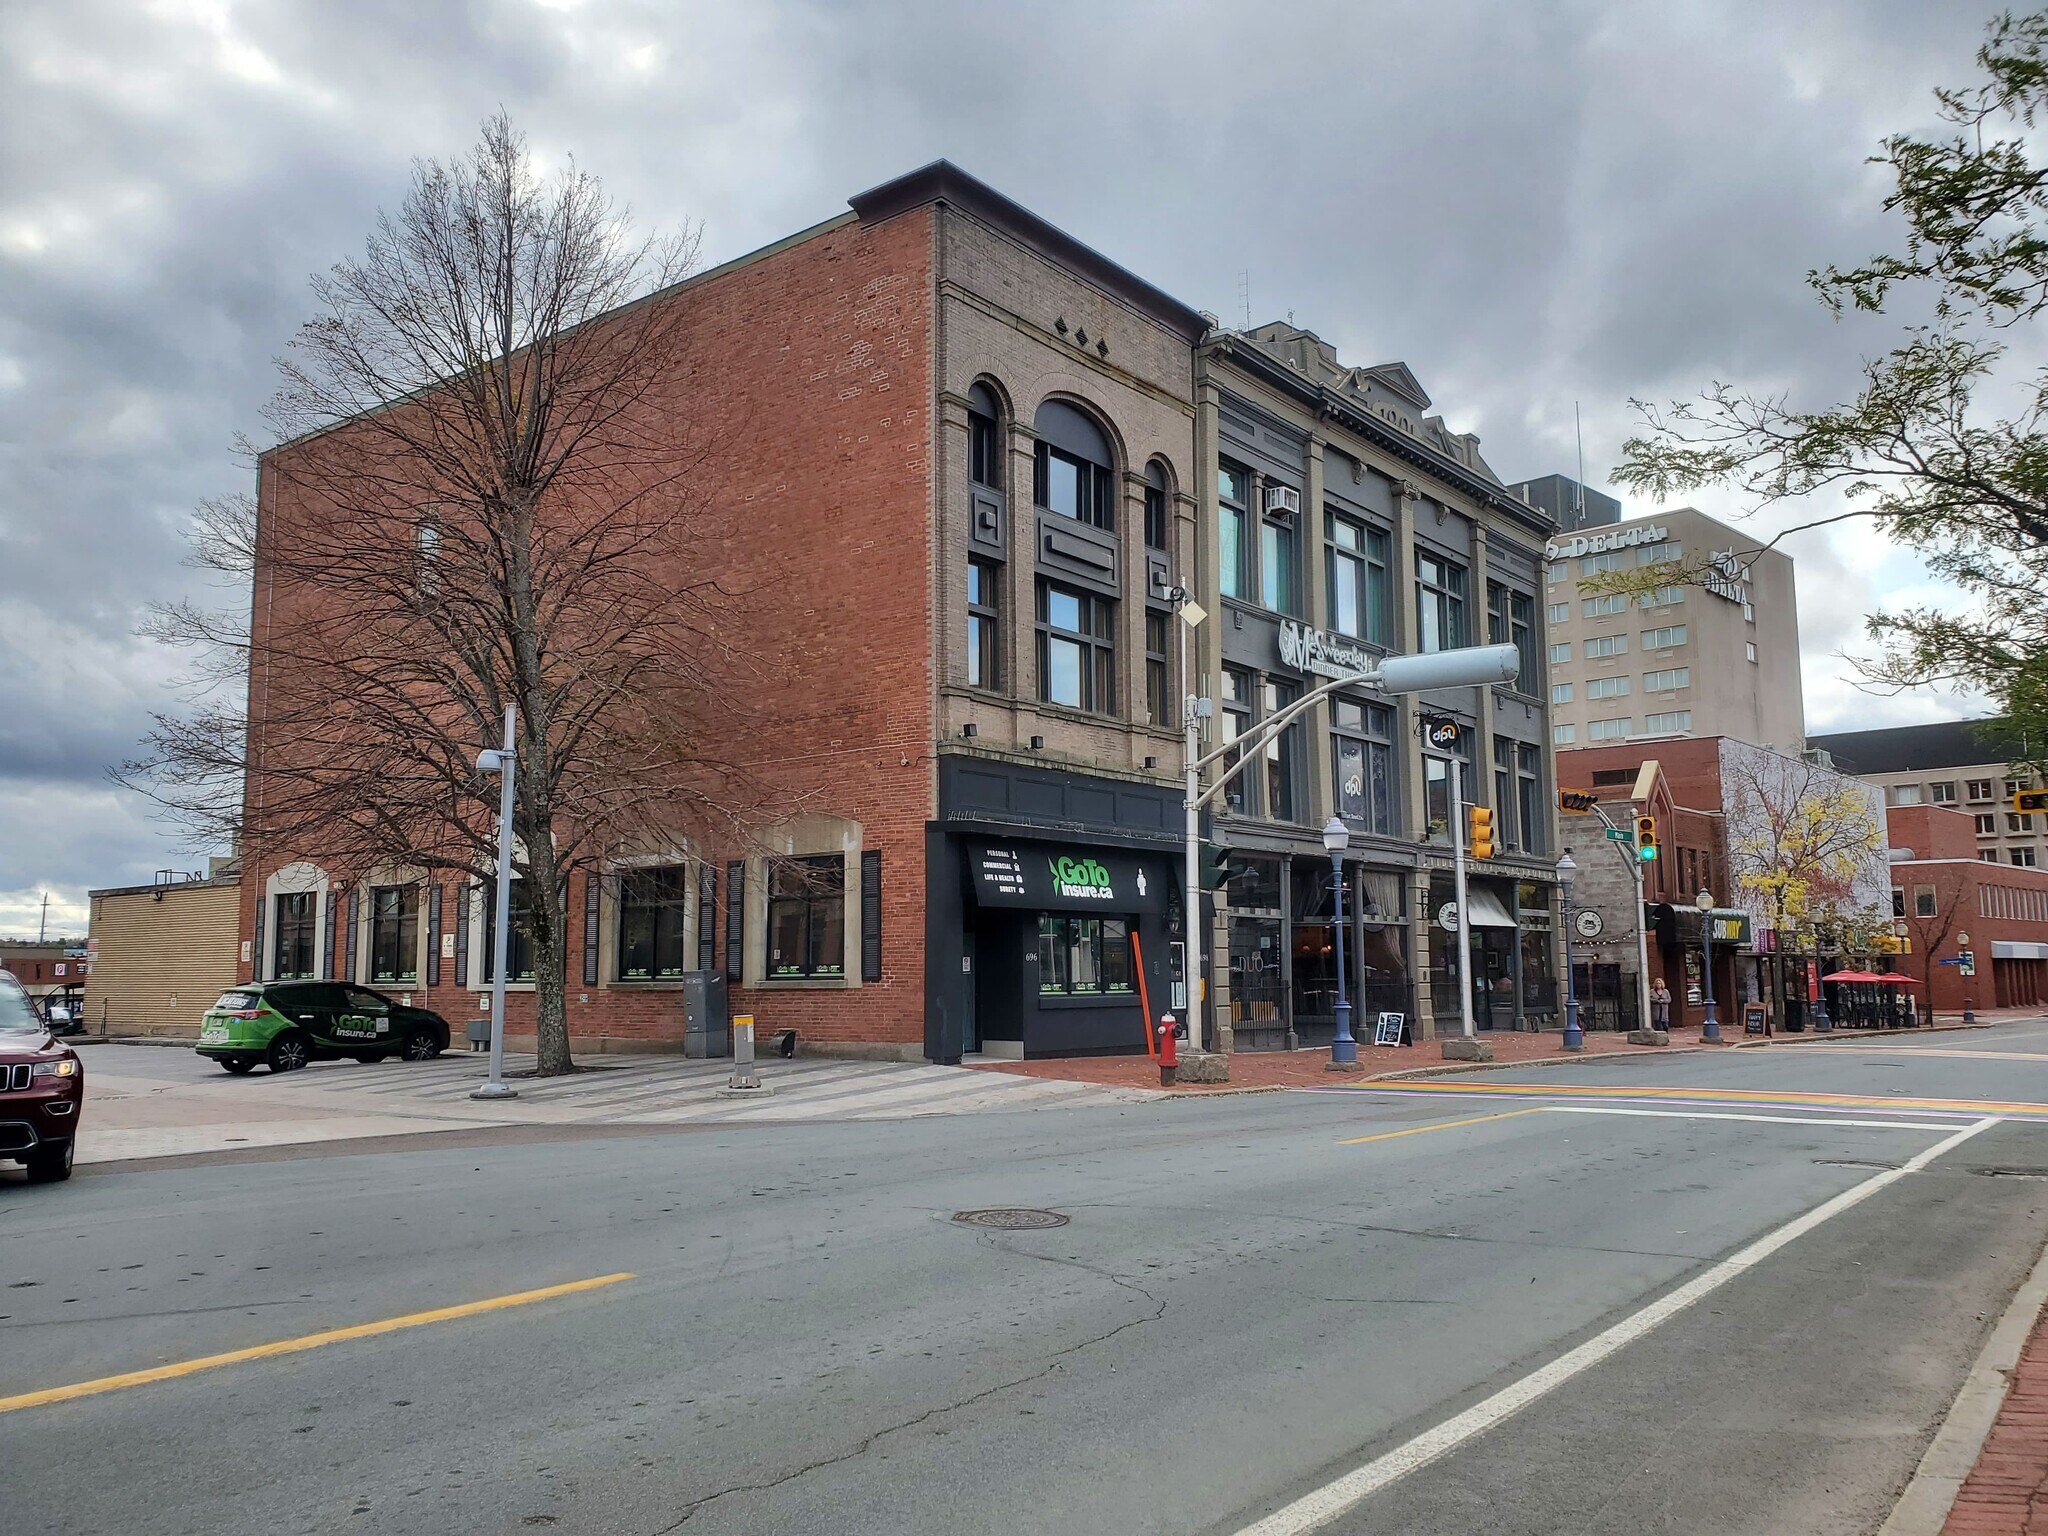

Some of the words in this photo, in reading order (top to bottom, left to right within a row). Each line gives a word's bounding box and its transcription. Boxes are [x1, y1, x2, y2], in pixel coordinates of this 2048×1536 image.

[1569, 524, 1662, 558] DELTA
[1708, 571, 1747, 605] DELTA
[1289, 622, 1368, 674] McSweeney
[1313, 662, 1339, 677] DINNER
[1432, 728, 1455, 742] dpl
[1344, 779, 1362, 797] dpl
[1614, 831, 1624, 840] Main
[983, 861, 1012, 870] COMMERCIAL
[1058, 856, 1110, 886] GoTo
[984, 873, 994, 881] LIFE
[998, 874, 1015, 882] HEALTH
[999, 885, 1016, 893] SURETY
[1061, 881, 1114, 899] insure.ca
[1712, 918, 1742, 939] SUBWAY
[1025, 953, 1038, 962] 696
[1239, 957, 1264, 972] DUO
[338, 1014, 376, 1031] GoTo
[336, 1027, 377, 1039] insure.ca
